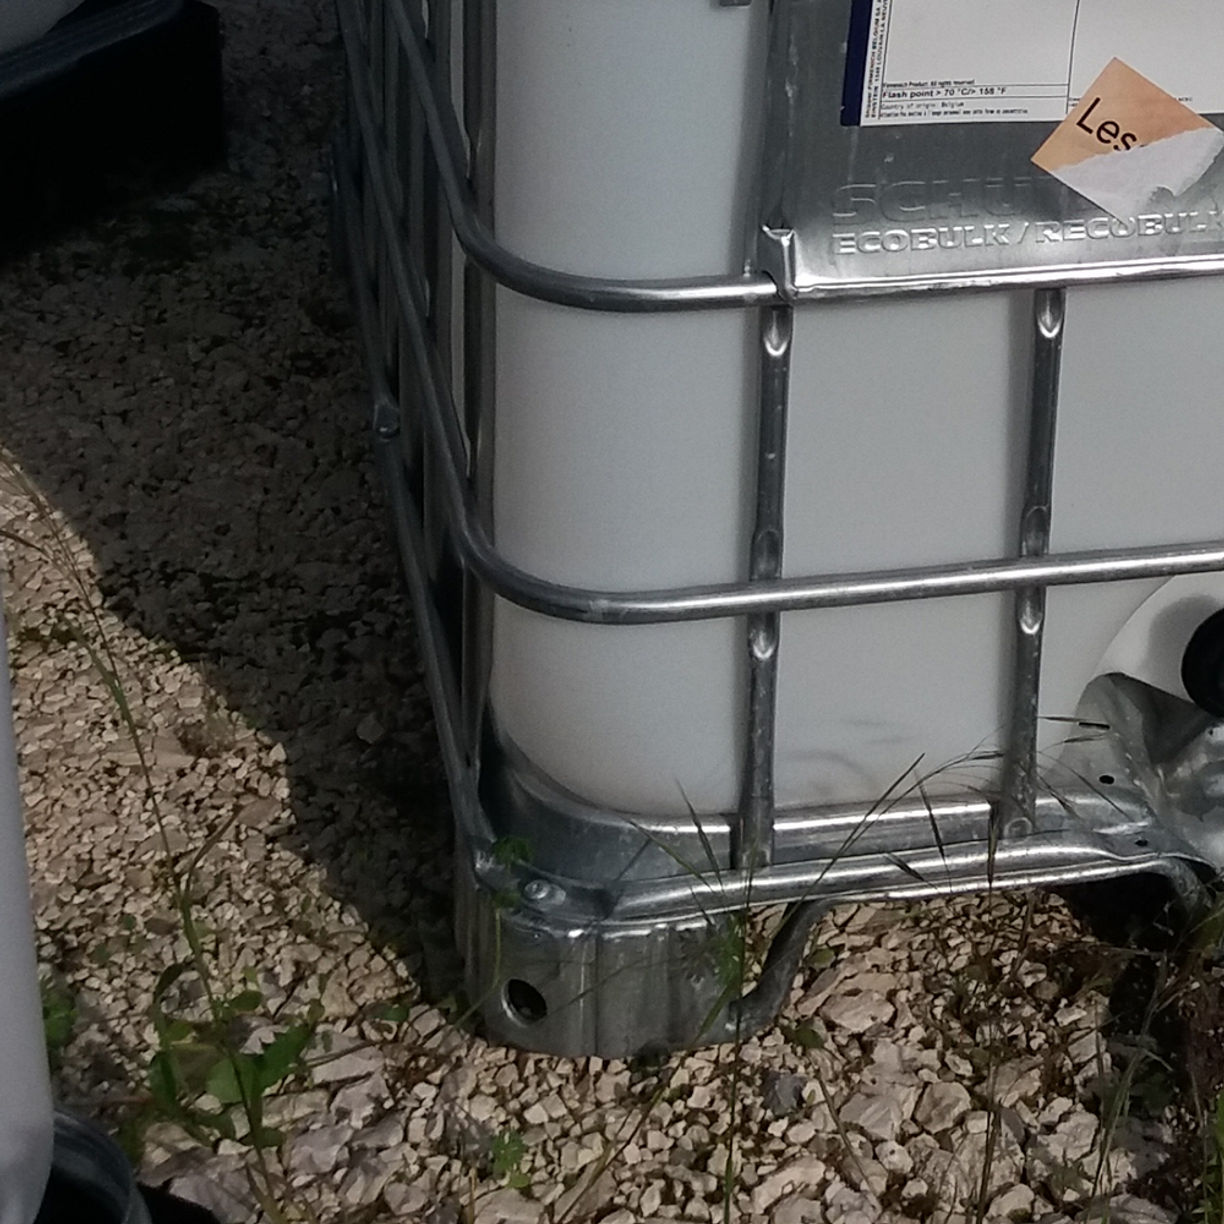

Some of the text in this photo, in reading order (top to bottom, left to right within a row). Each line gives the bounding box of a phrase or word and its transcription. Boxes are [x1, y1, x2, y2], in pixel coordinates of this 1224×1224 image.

[910, 90, 933, 99] point
[944, 88, 955, 96] 70
[1076, 97, 1137, 151] Les
